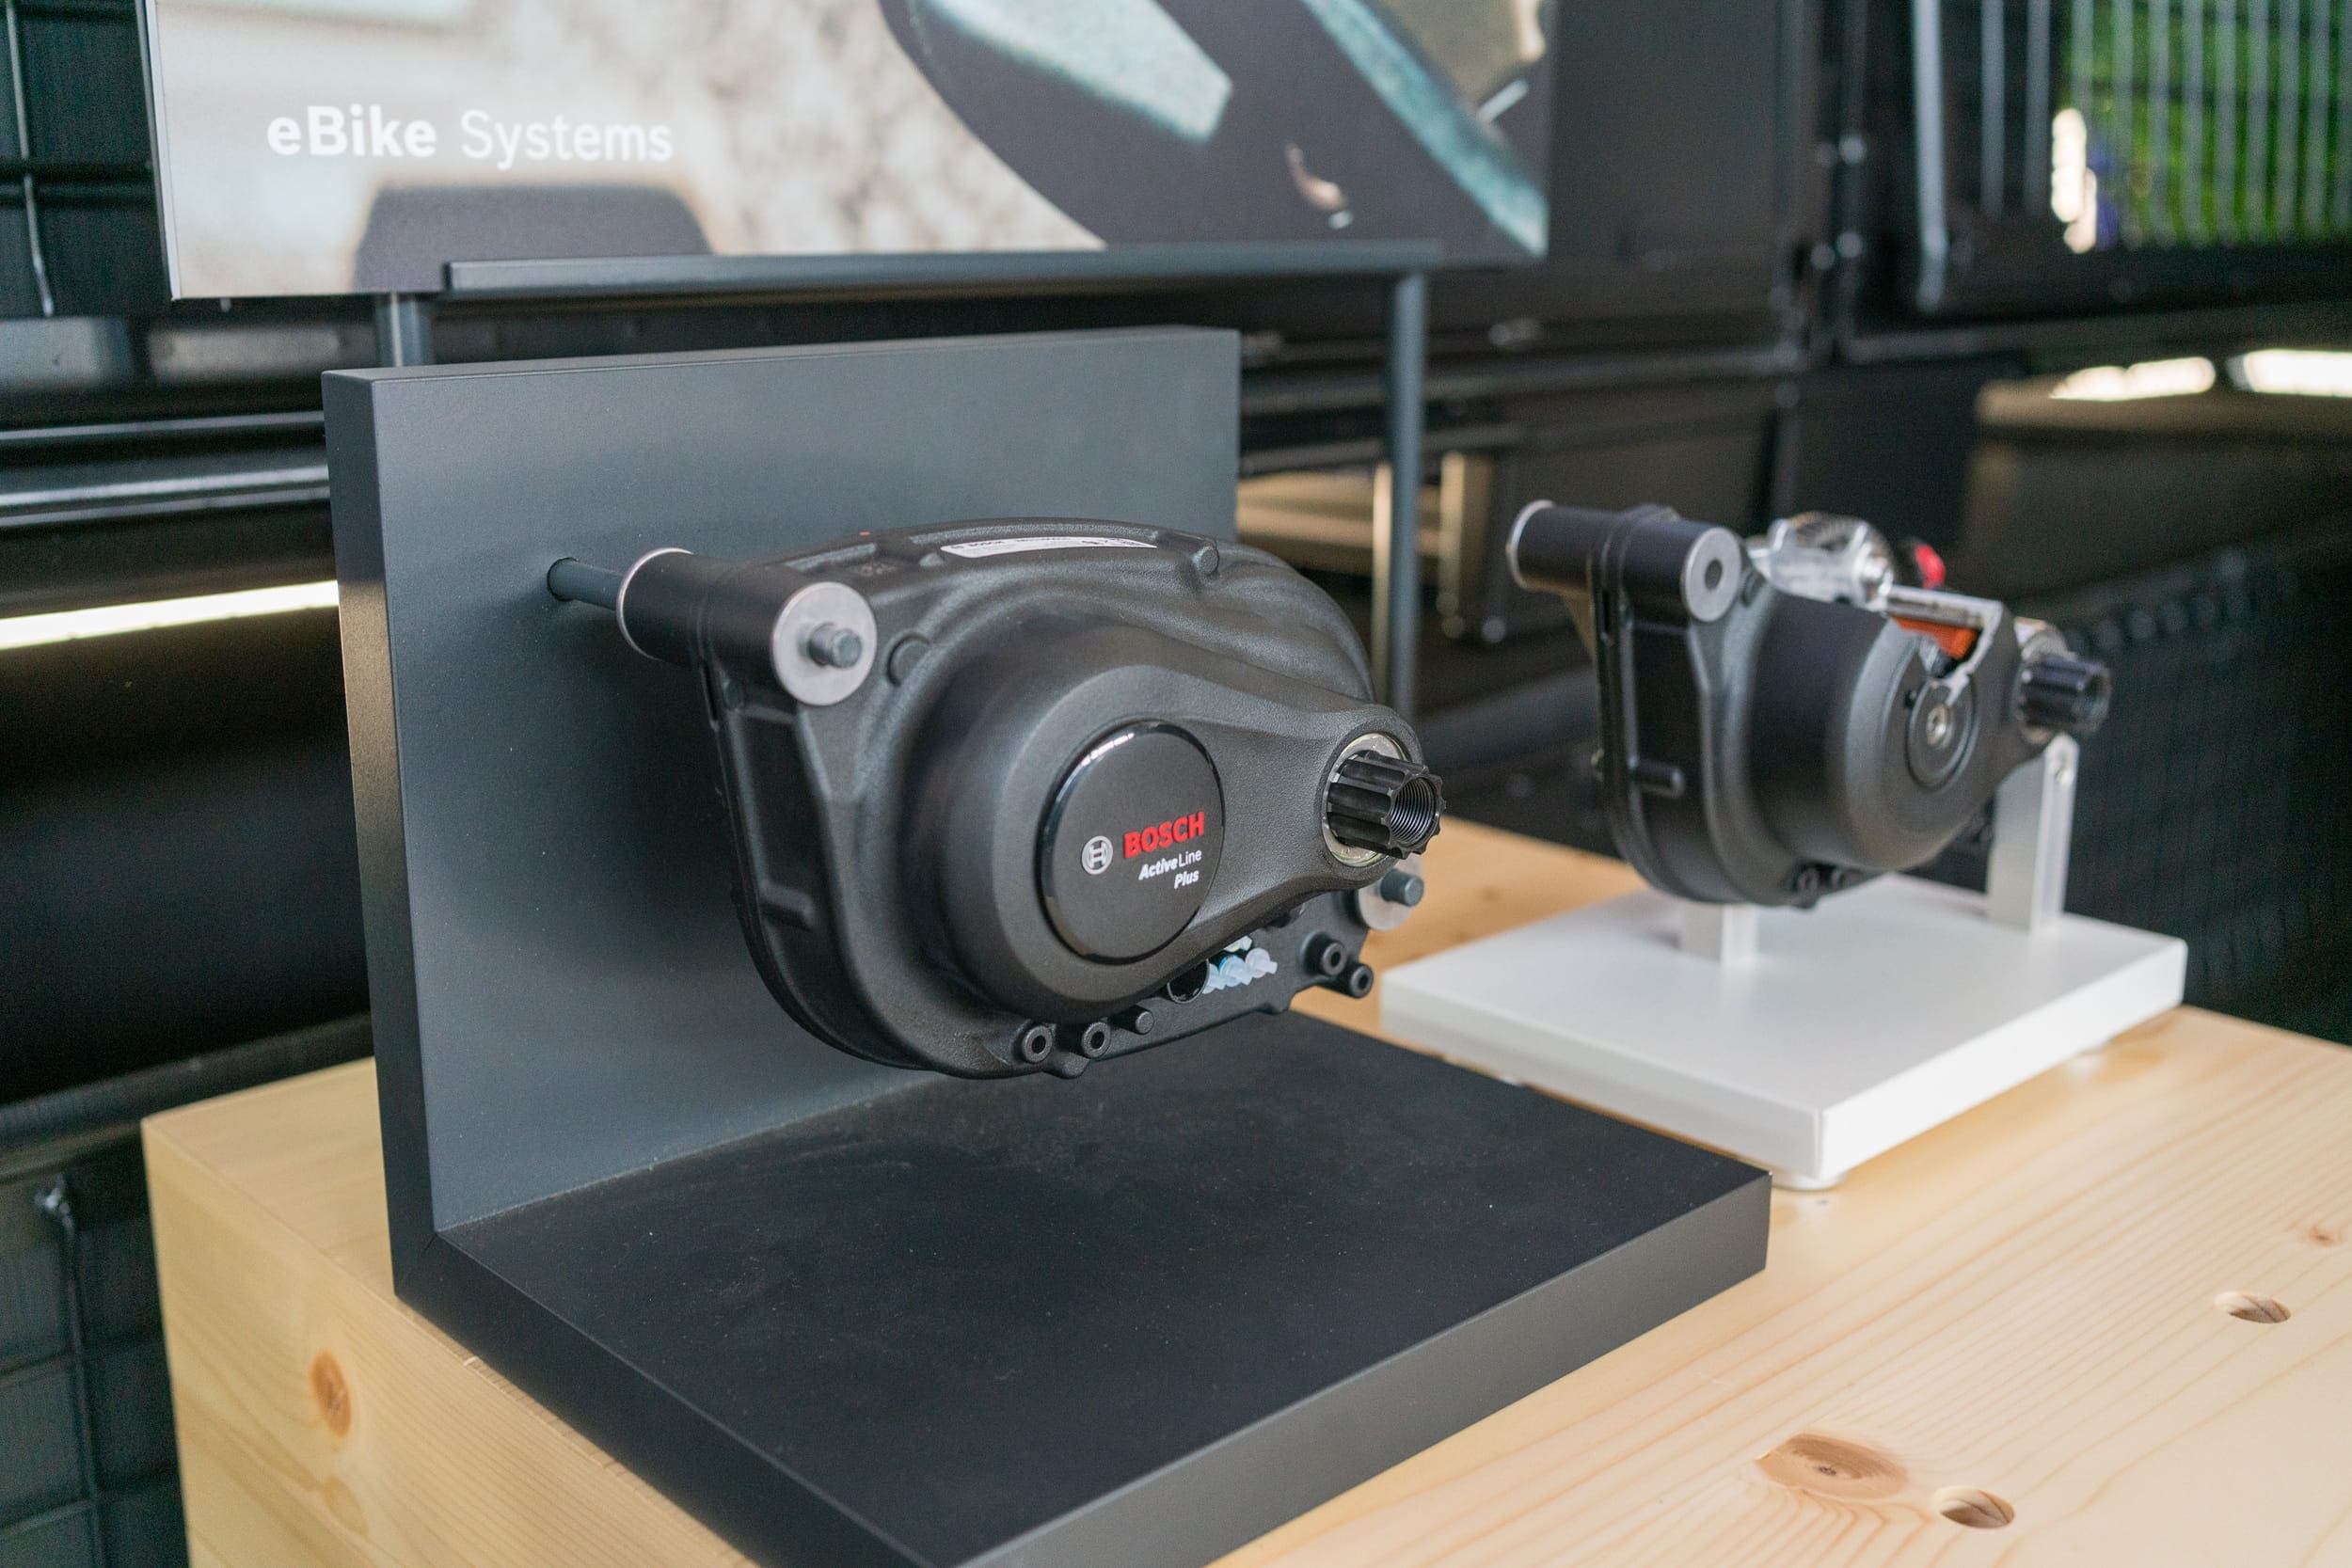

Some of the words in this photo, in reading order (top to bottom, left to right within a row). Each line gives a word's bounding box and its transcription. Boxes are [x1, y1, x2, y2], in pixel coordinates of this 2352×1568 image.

[266, 103, 437, 157] eBike
[460, 109, 674, 170] Systems
[1124, 811, 1204, 859] BOSCH
[1173, 870, 1200, 890] Plus
